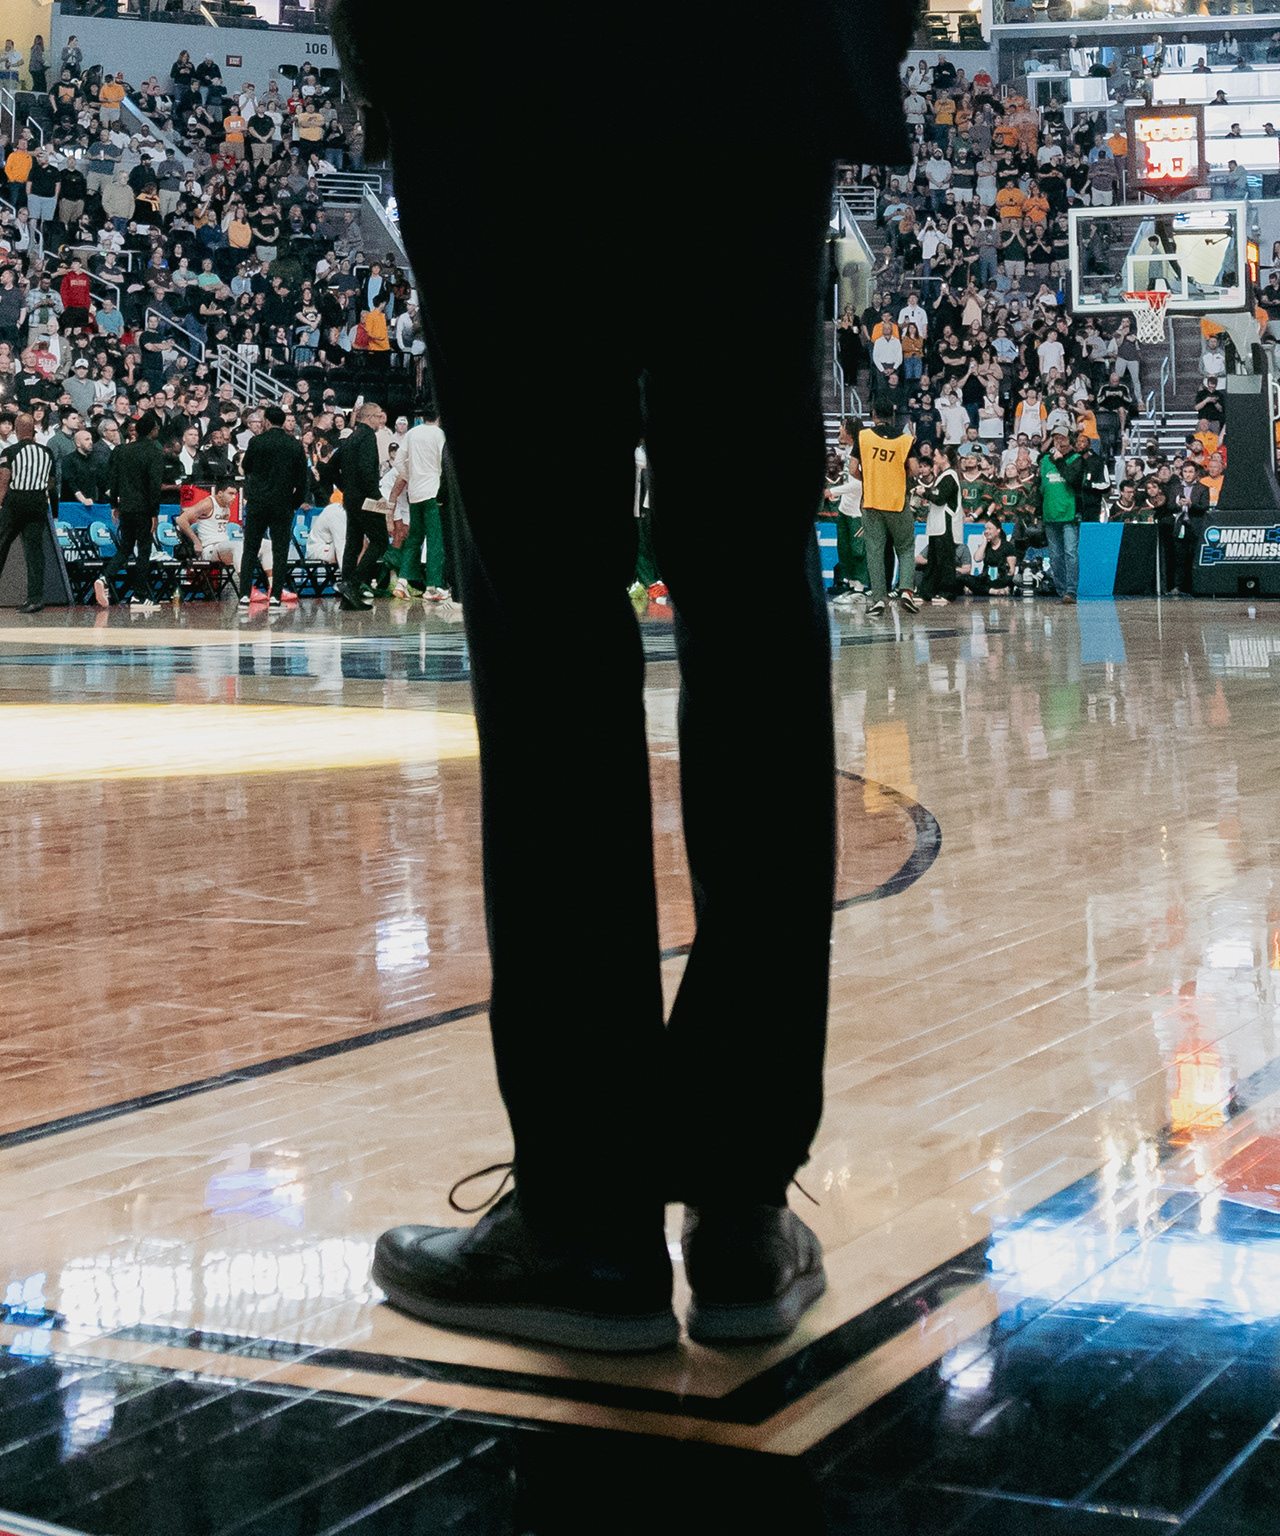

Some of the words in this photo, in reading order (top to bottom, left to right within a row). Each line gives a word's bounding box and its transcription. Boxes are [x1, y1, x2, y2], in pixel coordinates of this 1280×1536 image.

[305, 42, 328, 55] 106
[871, 446, 896, 463] 797
[1220, 529, 1266, 543] MARCH
